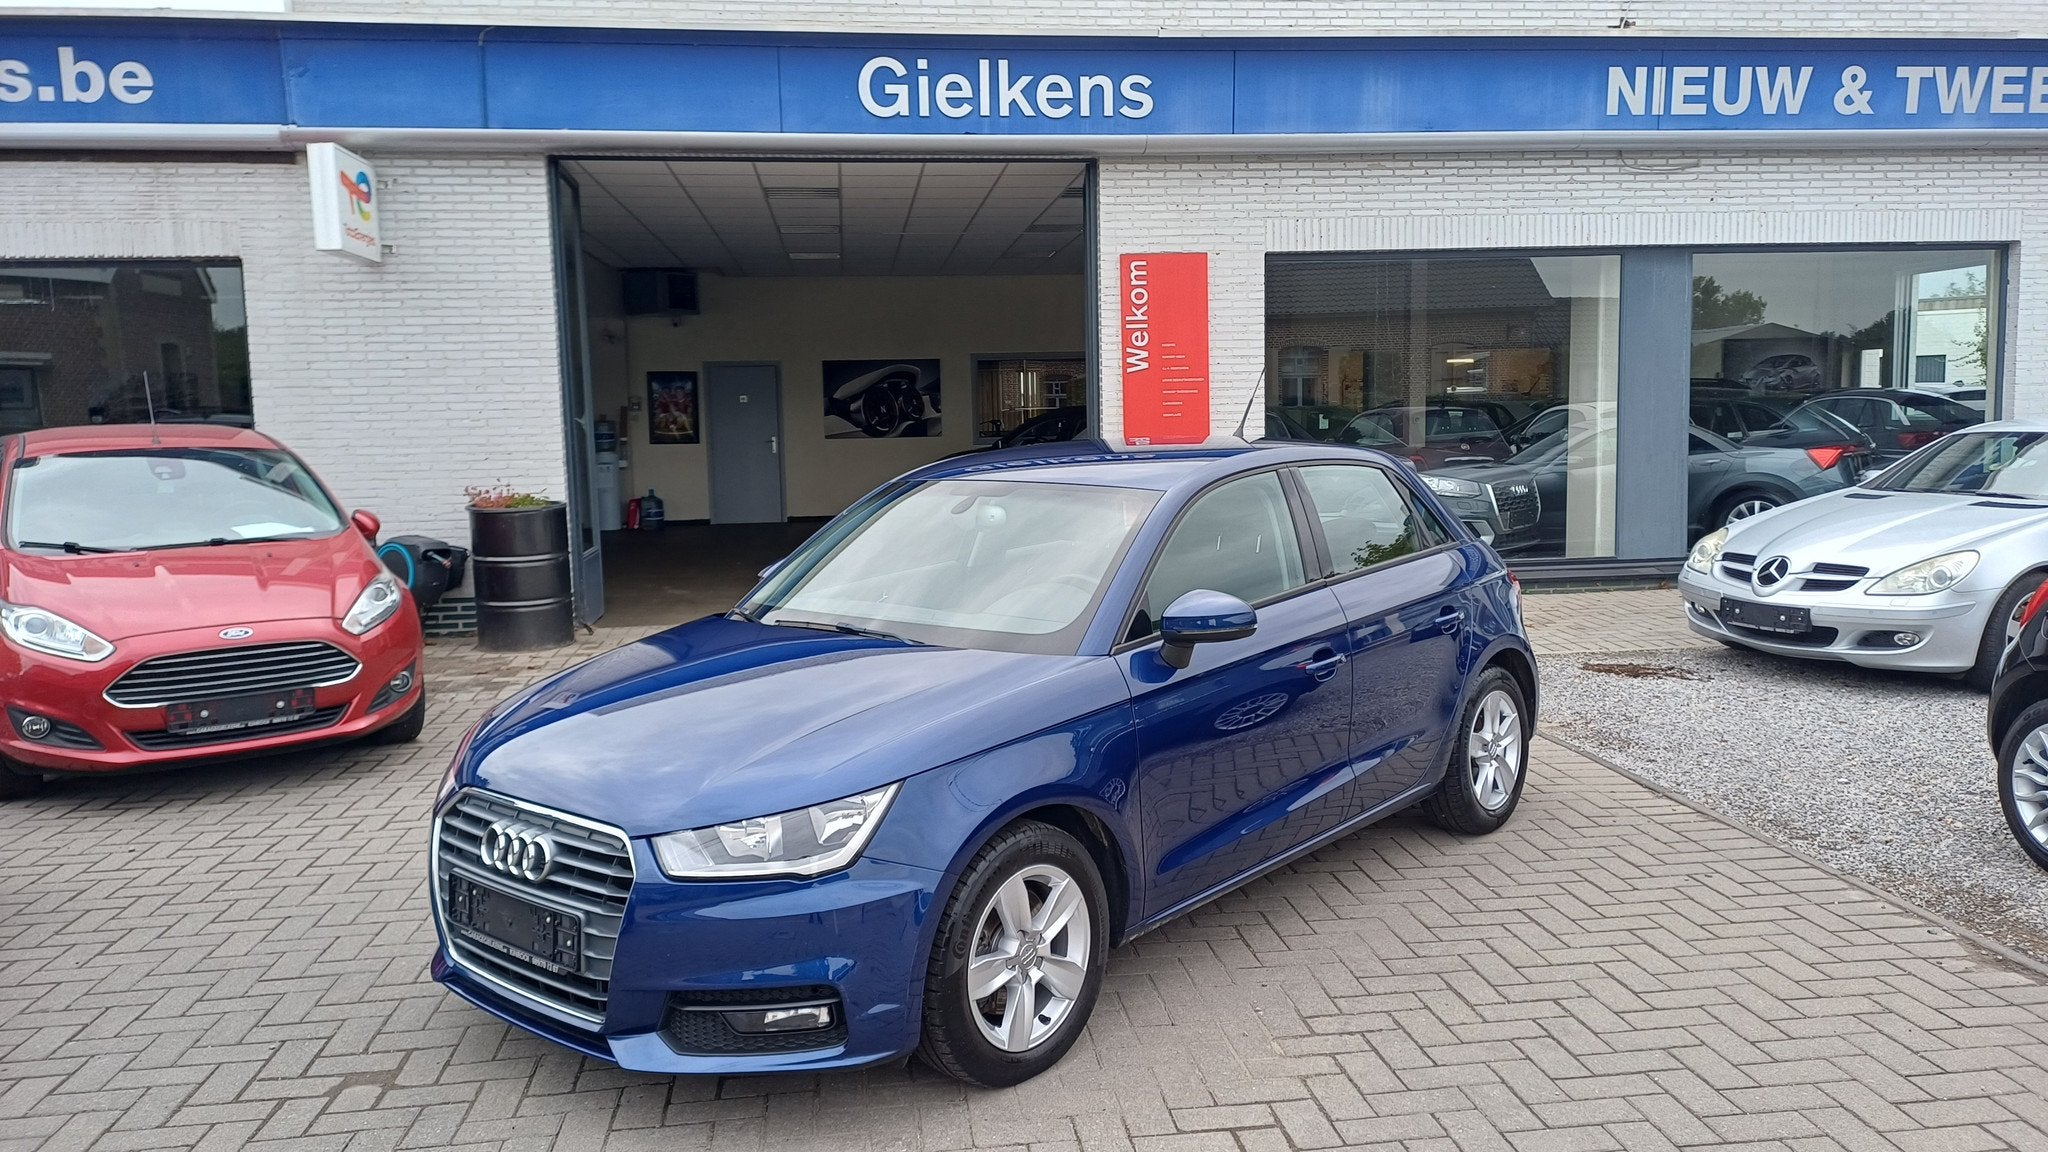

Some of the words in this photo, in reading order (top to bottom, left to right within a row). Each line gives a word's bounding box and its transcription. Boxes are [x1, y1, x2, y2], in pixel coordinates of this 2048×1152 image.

[0, 47, 154, 104] s.be
[858, 56, 1154, 119] Gielkens
[1607, 66, 1814, 116] NIEUW
[1833, 66, 1874, 116] &
[1126, 260, 1149, 374] Welkom
